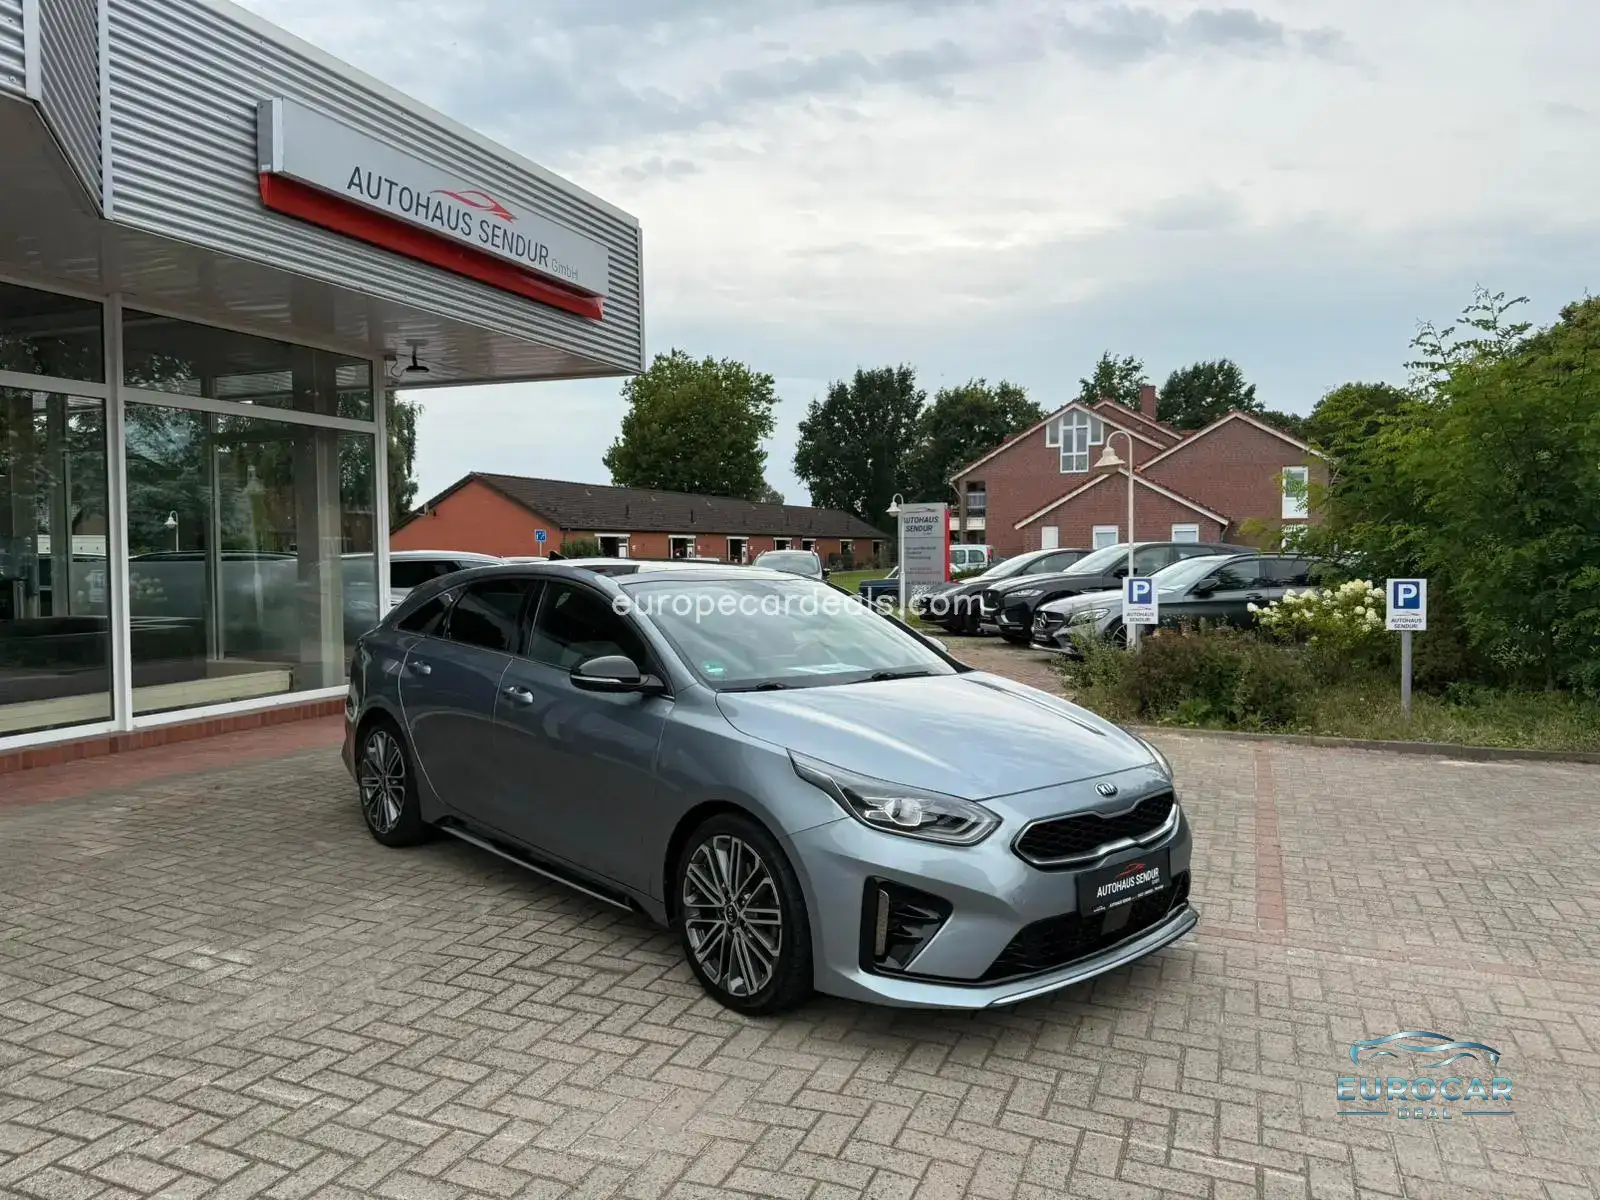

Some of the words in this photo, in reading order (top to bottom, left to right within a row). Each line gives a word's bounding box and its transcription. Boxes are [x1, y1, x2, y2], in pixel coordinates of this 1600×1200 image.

[347, 166, 473, 236] AUTOHAUS
[478, 219, 549, 268] SENDUR
[551, 258, 579, 281] GmbH
[1133, 581, 1150, 601] P
[1398, 584, 1417, 606] P
[1098, 783, 1116, 796] KIA
[1096, 876, 1135, 898] AUTOHAUS
[1136, 867, 1160, 885] SENDUR
